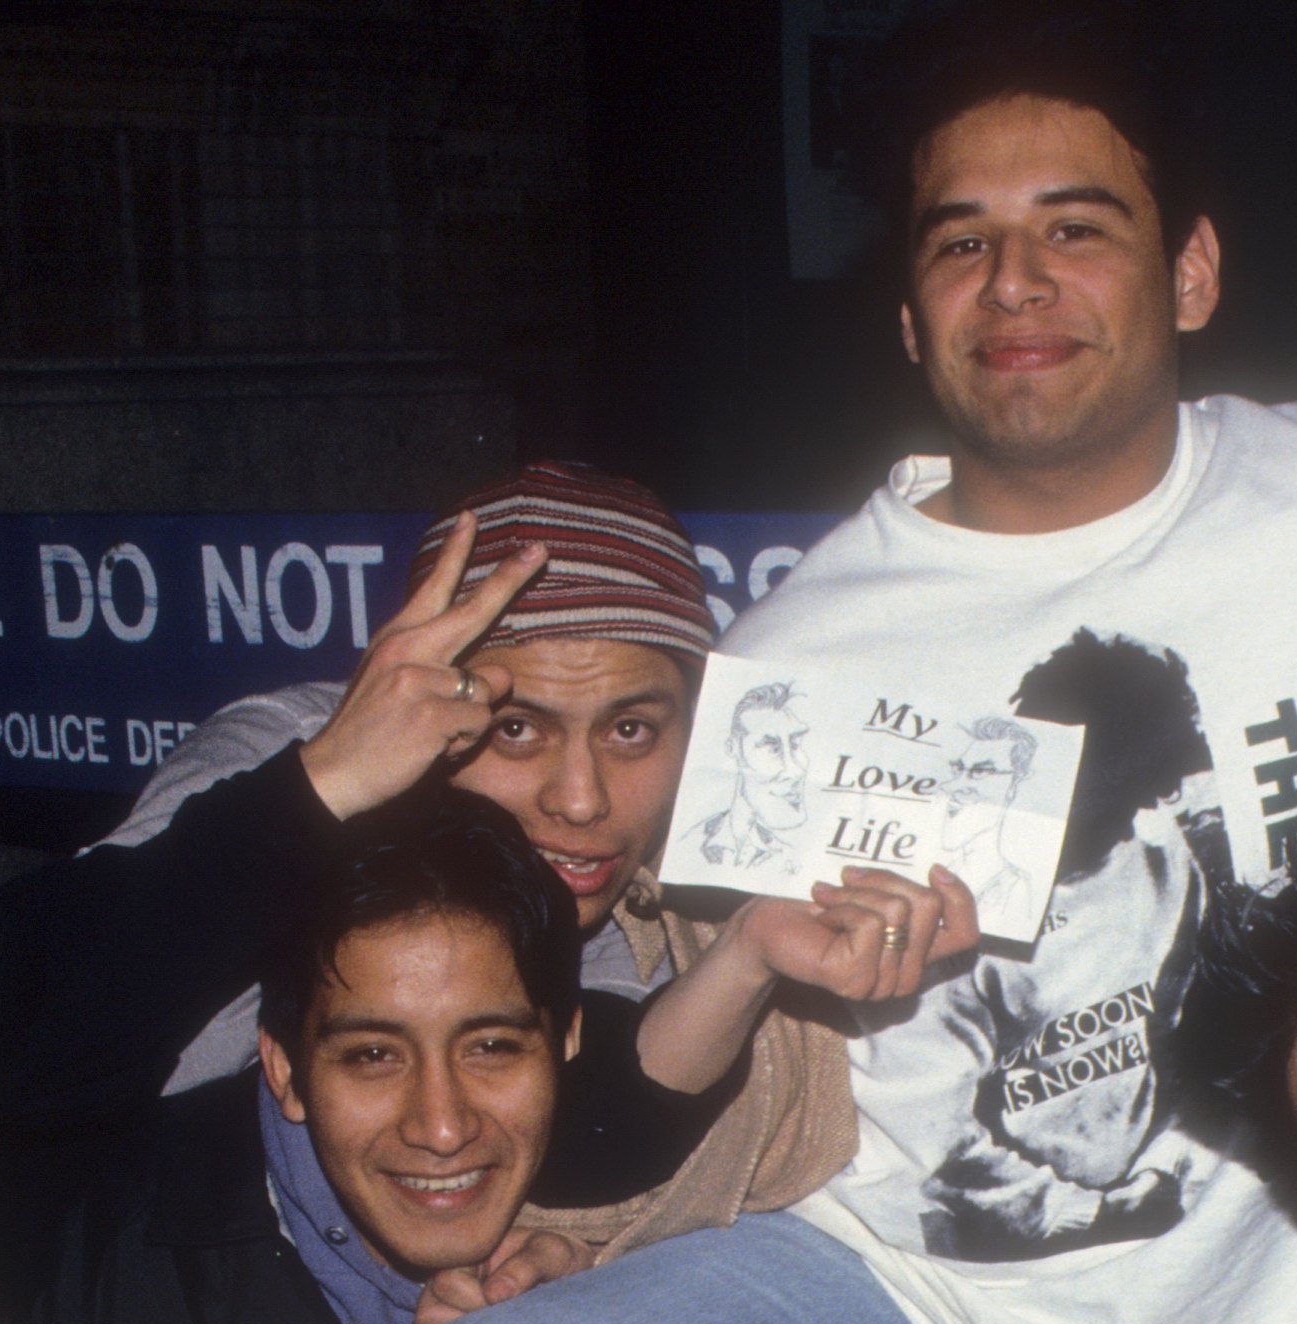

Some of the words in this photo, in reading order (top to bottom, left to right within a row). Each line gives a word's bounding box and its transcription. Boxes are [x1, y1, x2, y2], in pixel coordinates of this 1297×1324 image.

[38, 541, 159, 643] DO
[200, 541, 385, 650] NOT
[864, 697, 939, 742] My
[828, 754, 938, 797] Love
[827, 815, 918, 862] Life
[1054, 982, 1156, 1050] SOON
[1003, 1076, 1035, 1116] IS
[1037, 1034, 1143, 1099] NOW?
